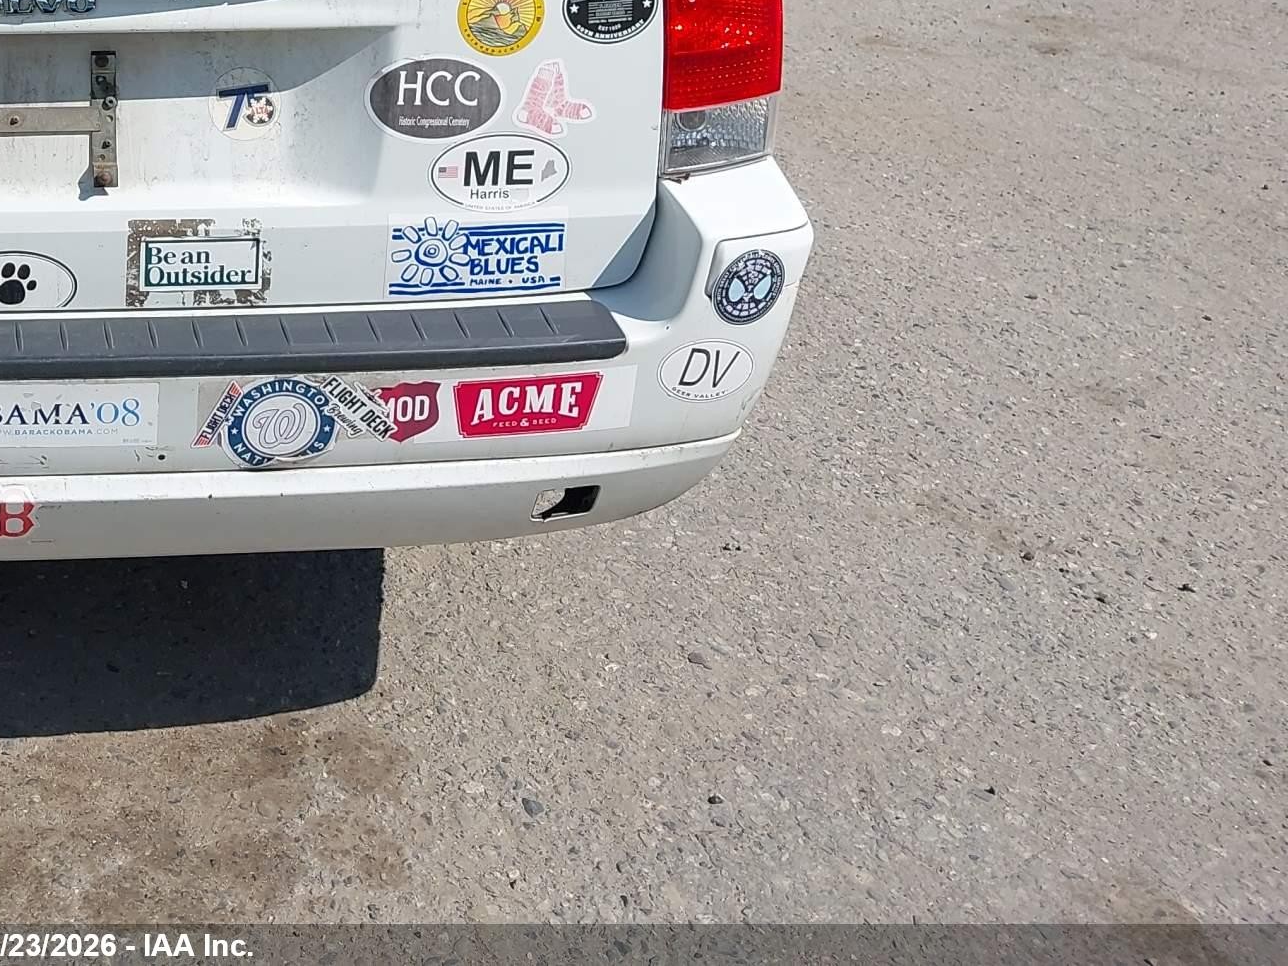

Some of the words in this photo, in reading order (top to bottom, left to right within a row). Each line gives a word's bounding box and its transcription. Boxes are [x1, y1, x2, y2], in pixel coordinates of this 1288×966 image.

[594, 18, 645, 39] ANNIVERSARY
[396, 70, 481, 106] HCC
[416, 116, 448, 128] Congressional
[448, 116, 470, 128] Cemetery
[463, 149, 535, 187] ME
[470, 188, 510, 200] Harris
[148, 246, 177, 265] Be
[180, 250, 211, 265] an
[462, 233, 564, 257] MEXICALI
[147, 265, 252, 284] Outsider
[469, 255, 540, 276] BLUES
[469, 277, 503, 286] MAINE
[521, 275, 546, 284] USA
[678, 347, 741, 389] DV
[470, 381, 583, 426] ACME
[693, 389, 727, 399] VALLEY
[201, 410, 221, 439] FLIGHT
[218, 393, 236, 418] DECK
[322, 377, 368, 414] FLIGHT
[359, 409, 397, 440] DECK
[328, 402, 364, 436] Brewing
[493, 420, 518, 428] FEED
[519, 417, 530, 427] &
[532, 417, 558, 425] SEED
